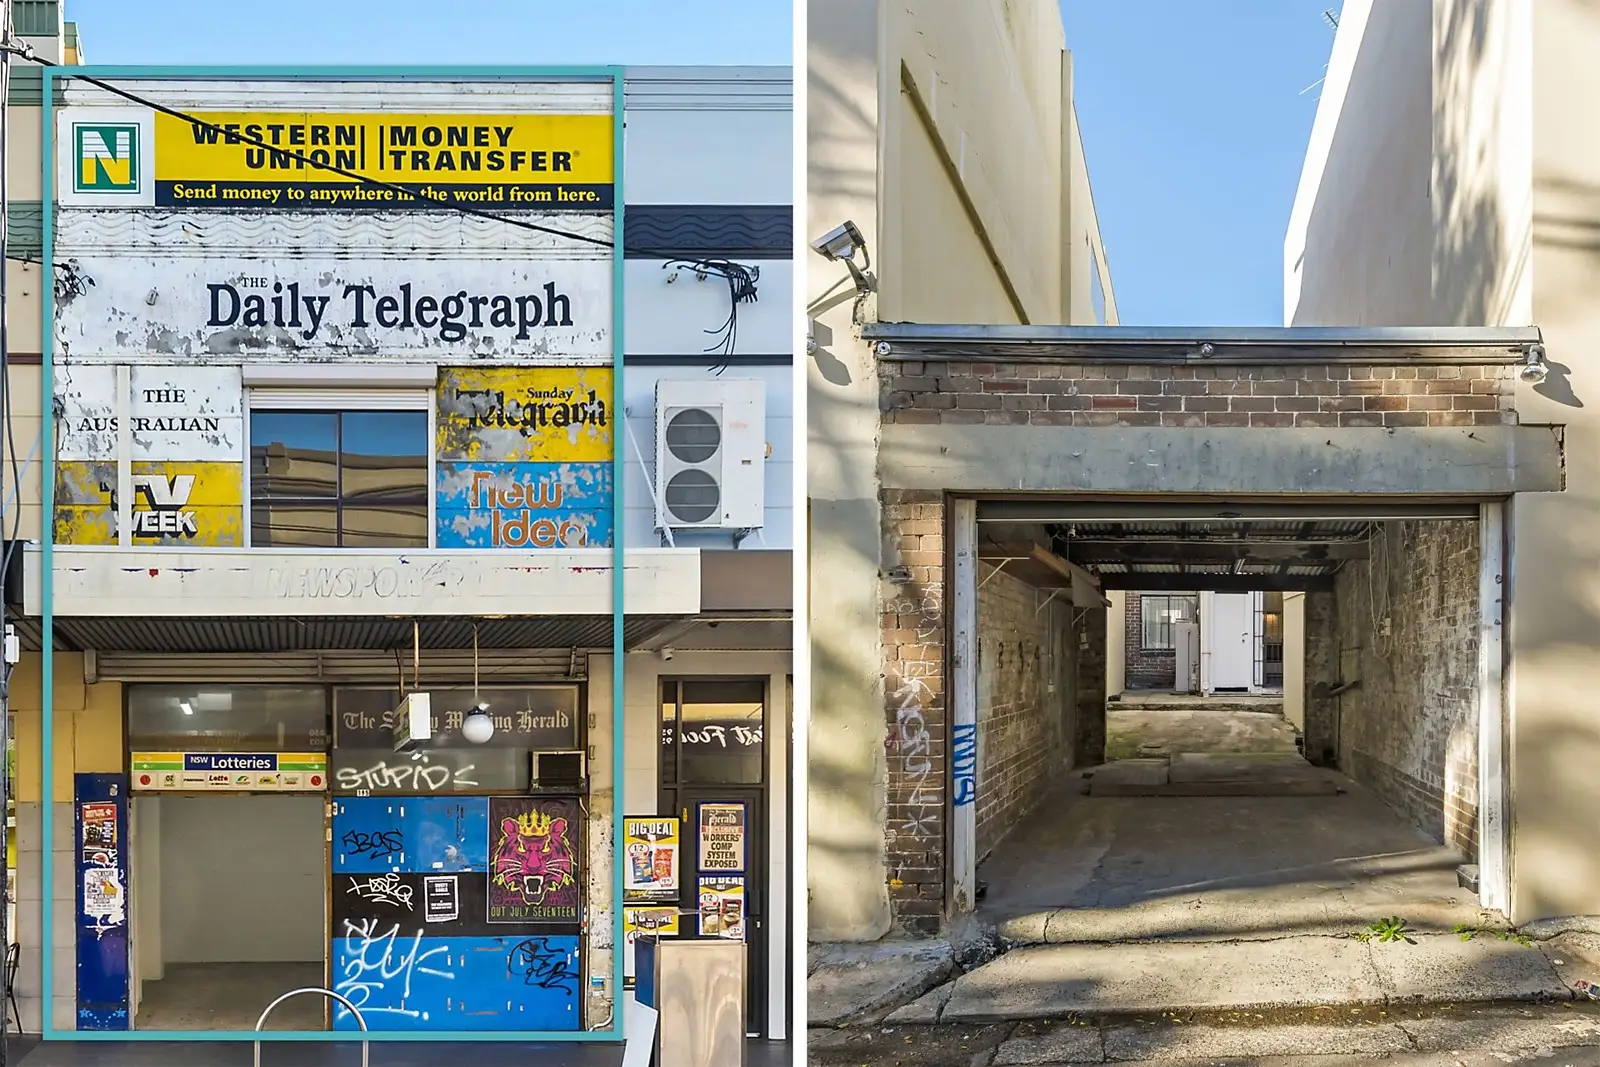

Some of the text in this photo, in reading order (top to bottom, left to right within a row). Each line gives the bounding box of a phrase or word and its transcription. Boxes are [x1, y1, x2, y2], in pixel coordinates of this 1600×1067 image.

[192, 124, 514, 147] WESTERN MONEY
[82, 130, 130, 184] N
[246, 149, 572, 172] UNION TRANSFER
[173, 184, 217, 199] Send
[221, 187, 281, 203] money
[287, 186, 305, 199] to
[310, 184, 393, 203] anywhere
[420, 186, 447, 201] the
[453, 186, 504, 201] world
[510, 186, 552, 201] from
[557, 186, 601, 201] here.
[241, 277, 268, 288] THE
[206, 282, 574, 341] Daily Telegraph
[143, 389, 186, 403] THE
[526, 386, 574, 404] Sunday
[78, 417, 220, 432] AUSRALIAN
[491, 509, 588, 548] Idea
[342, 710, 376, 730] The
[444, 710, 513, 734] Ming
[516, 709, 569, 733] Herald
[211, 756, 271, 769] Lotteries
[628, 822, 675, 836] BIG DEAL
[711, 842, 733, 851] COMP
[707, 851, 736, 860] SYSTEM
[704, 860, 738, 869] EXPOSED
[491, 906, 576, 918] OUT JULY SEVENTEEN
